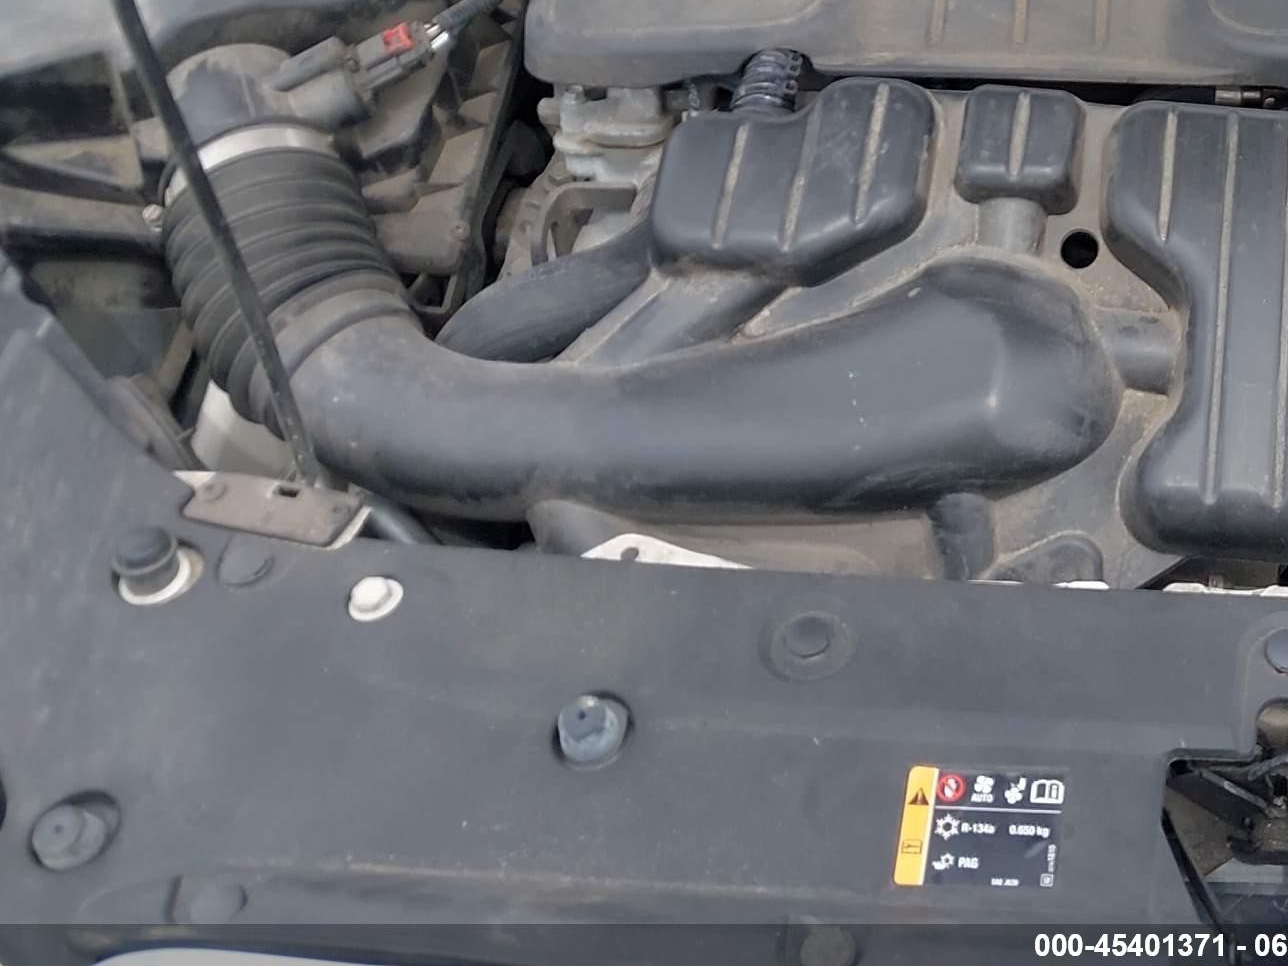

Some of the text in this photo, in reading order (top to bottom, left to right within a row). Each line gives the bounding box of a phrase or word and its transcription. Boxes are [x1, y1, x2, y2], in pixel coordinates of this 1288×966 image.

[970, 792, 994, 804] AUTO
[1036, 825, 1050, 839] kg
[957, 856, 980, 870] PAG
